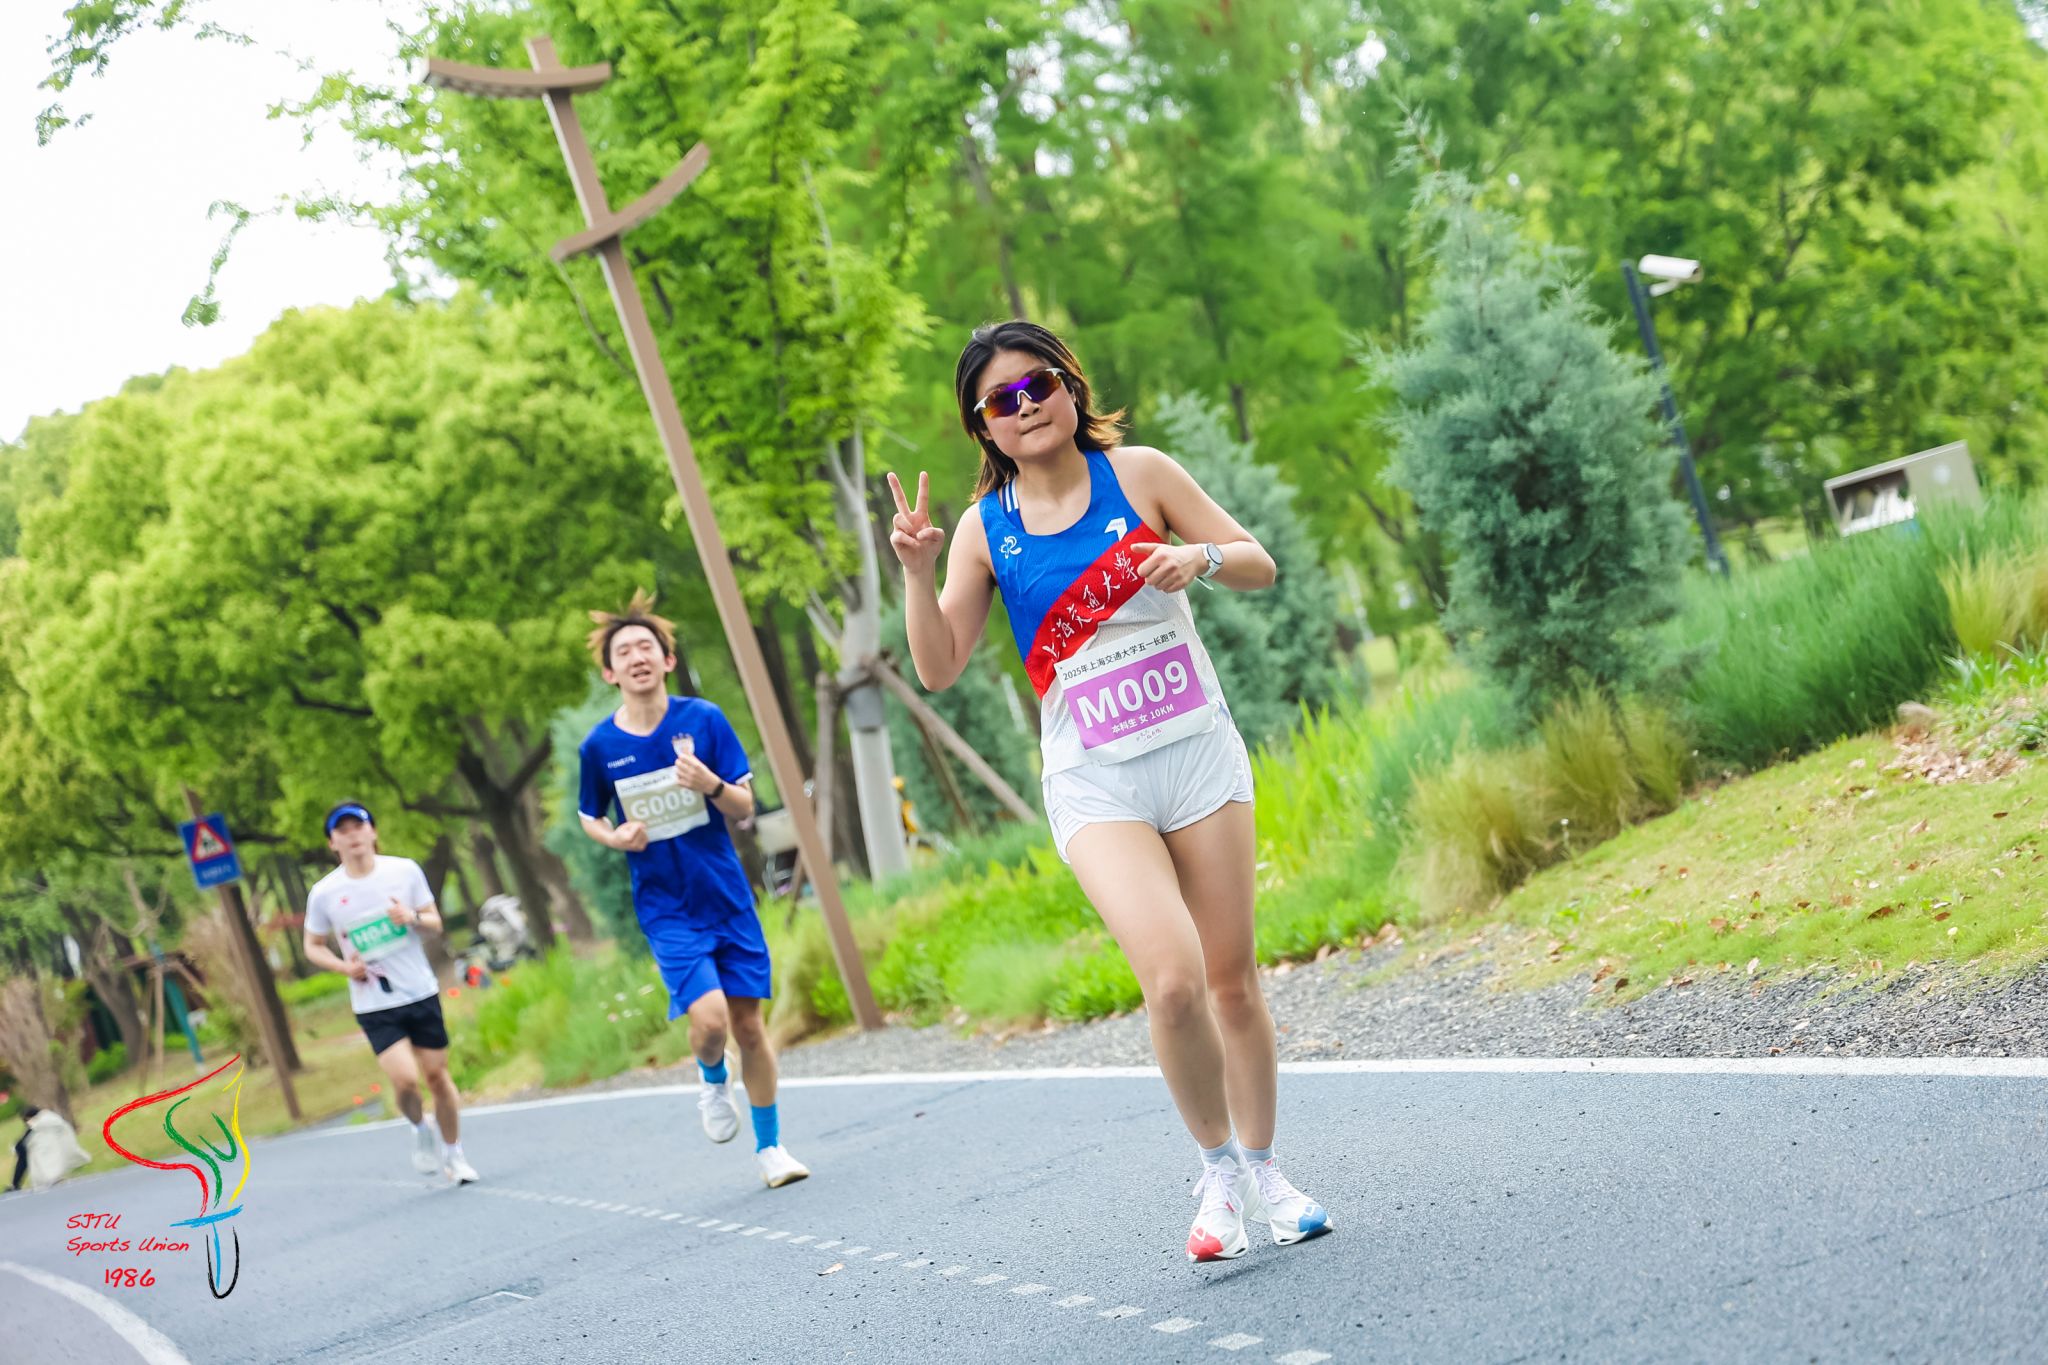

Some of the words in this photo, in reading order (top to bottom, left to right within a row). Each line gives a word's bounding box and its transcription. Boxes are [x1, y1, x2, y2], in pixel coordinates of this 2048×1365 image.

[1063, 630, 1177, 680] 2025年上海交通大学五一长跑节
[1076, 660, 1188, 729] M009
[1111, 718, 1138, 734] 本科生
[1138, 713, 1149, 725] 女
[1150, 703, 1175, 720] 10KM
[631, 788, 696, 819] G008
